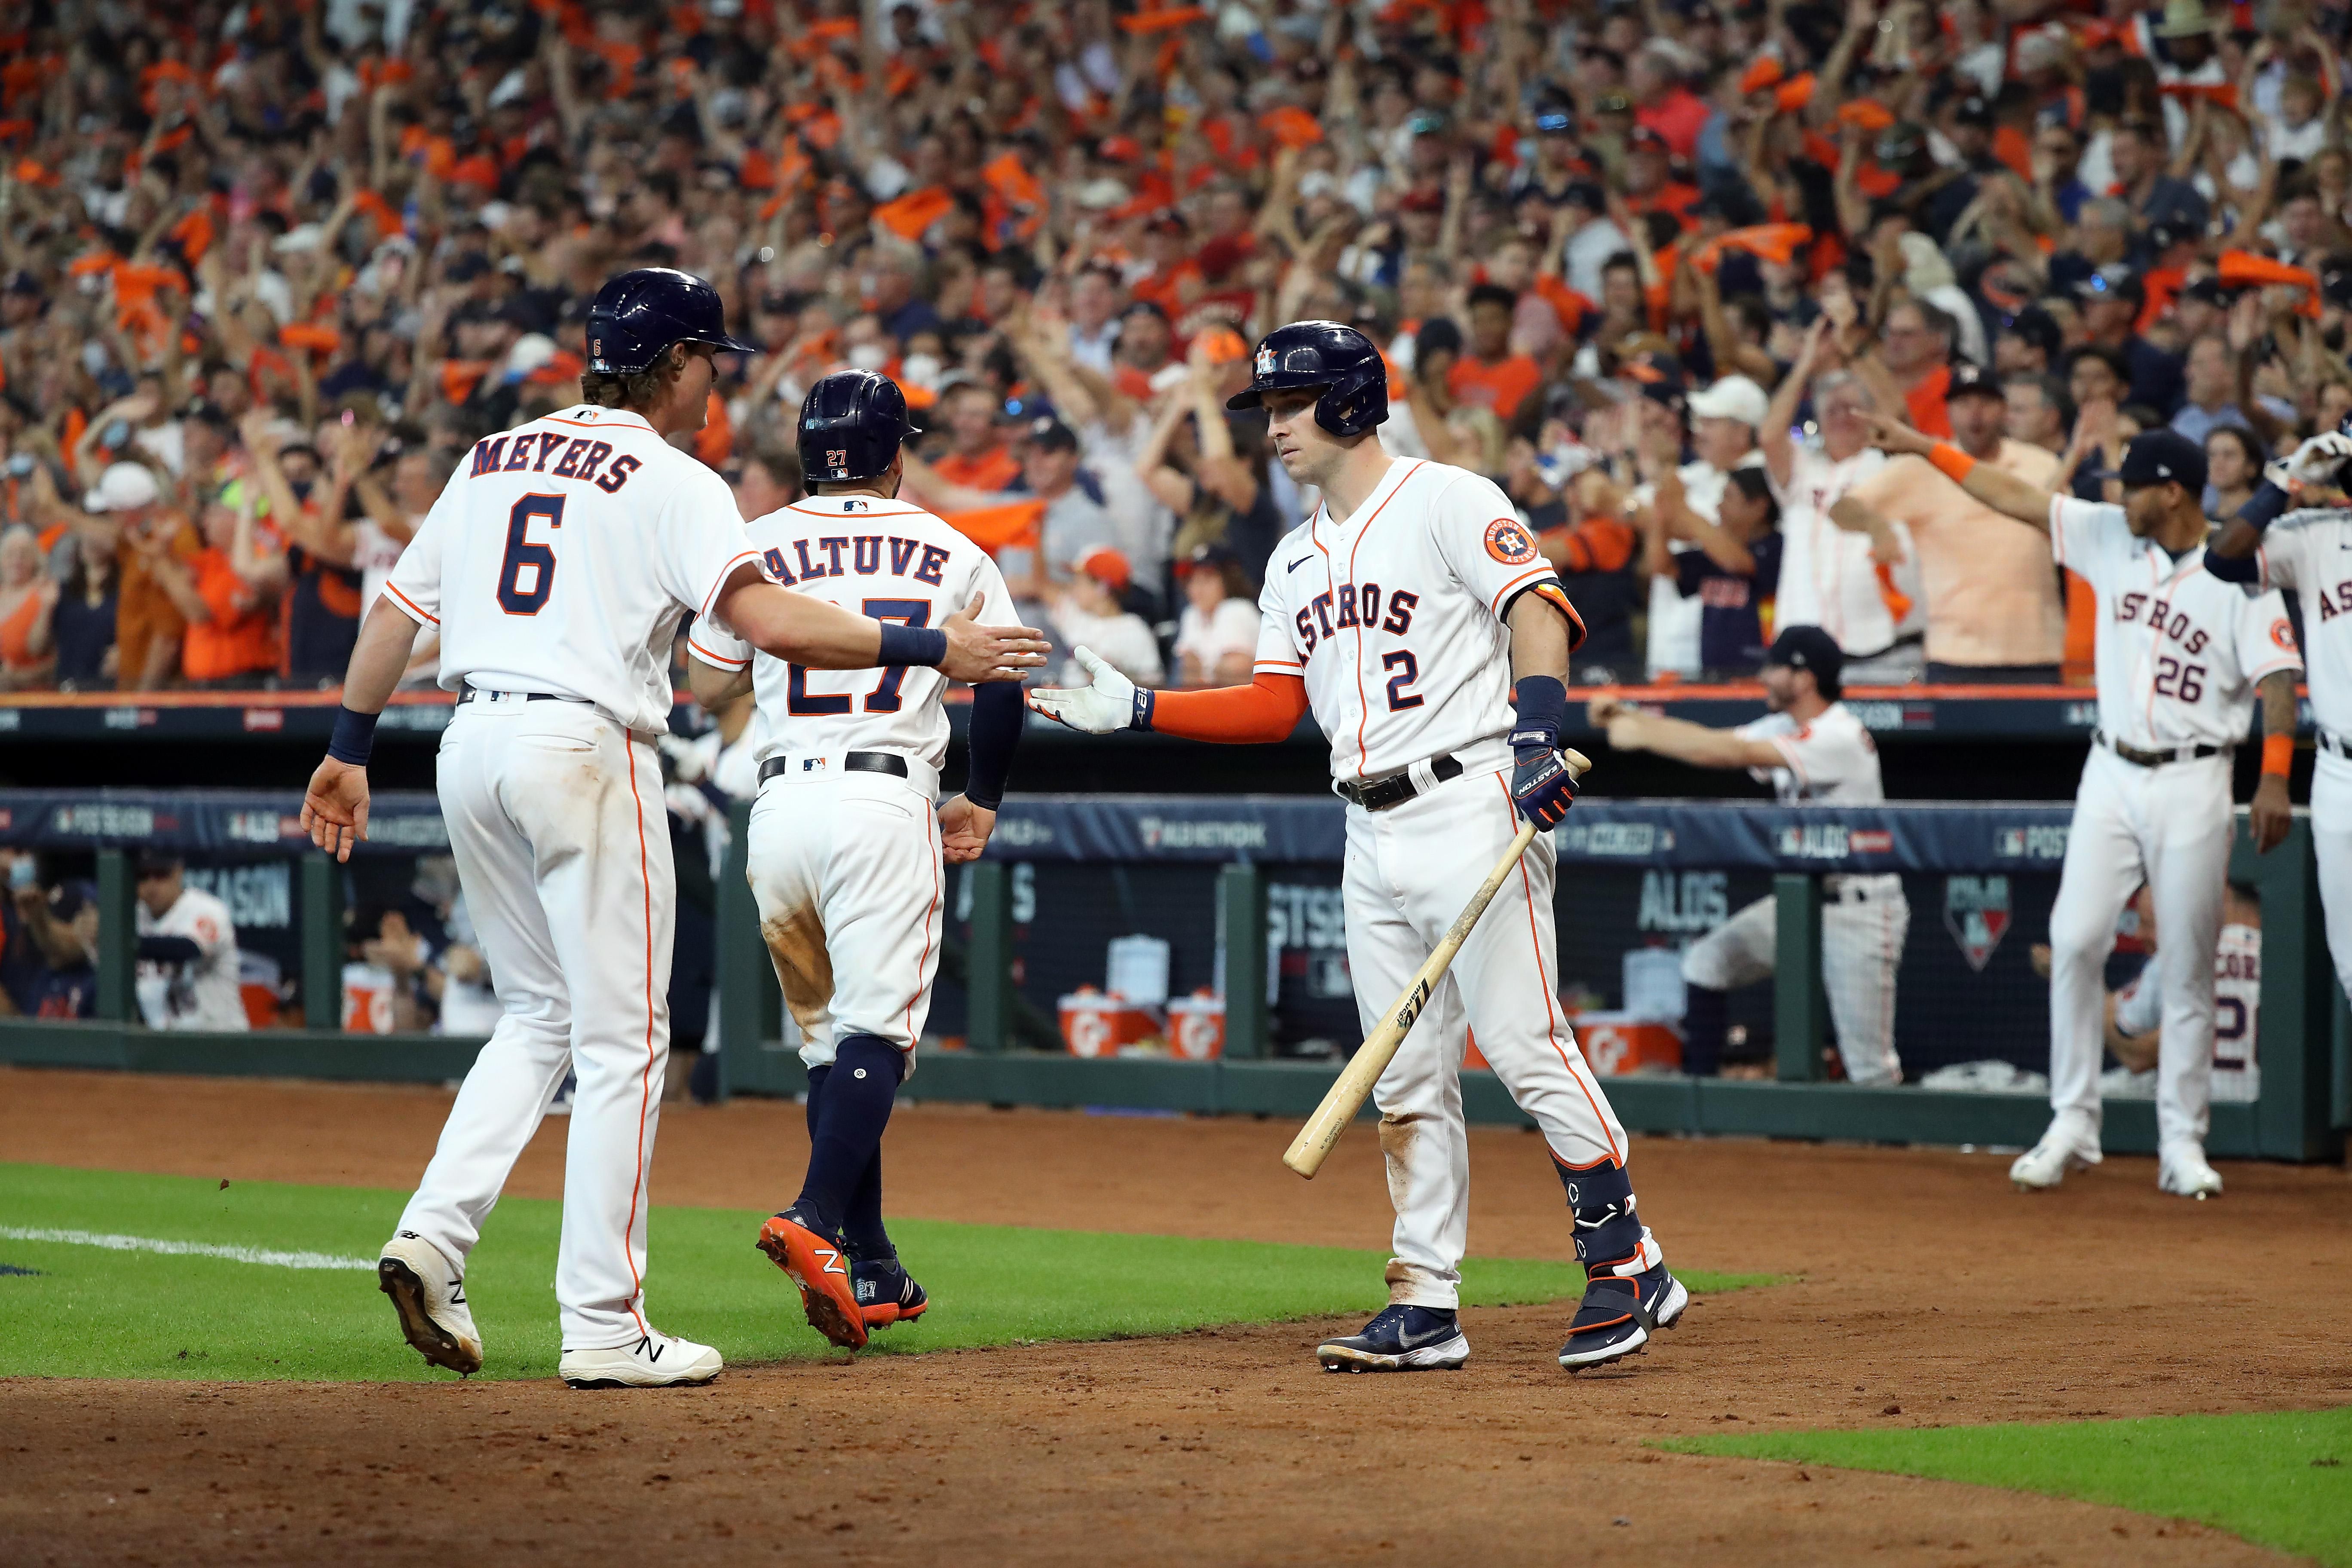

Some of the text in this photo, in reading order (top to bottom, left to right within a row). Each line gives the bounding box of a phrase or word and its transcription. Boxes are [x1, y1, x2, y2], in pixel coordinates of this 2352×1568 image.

[594, 339, 601, 356] 6
[469, 432, 643, 493] MEYERS
[826, 450, 846, 466] 27
[1487, 521, 1519, 541] HOUSTON
[1499, 532, 1524, 552] H
[496, 492, 567, 616] 6
[763, 536, 951, 588] ALTUVE
[1506, 546, 1535, 563] ASTROS
[1296, 582, 1420, 669] STROS
[1381, 649, 1424, 712] 2
[2156, 657, 2206, 702] 26
[1519, 764, 1558, 795] EASTON
[1396, 984, 1421, 1023] marucci
[857, 1276, 877, 1300] 27
